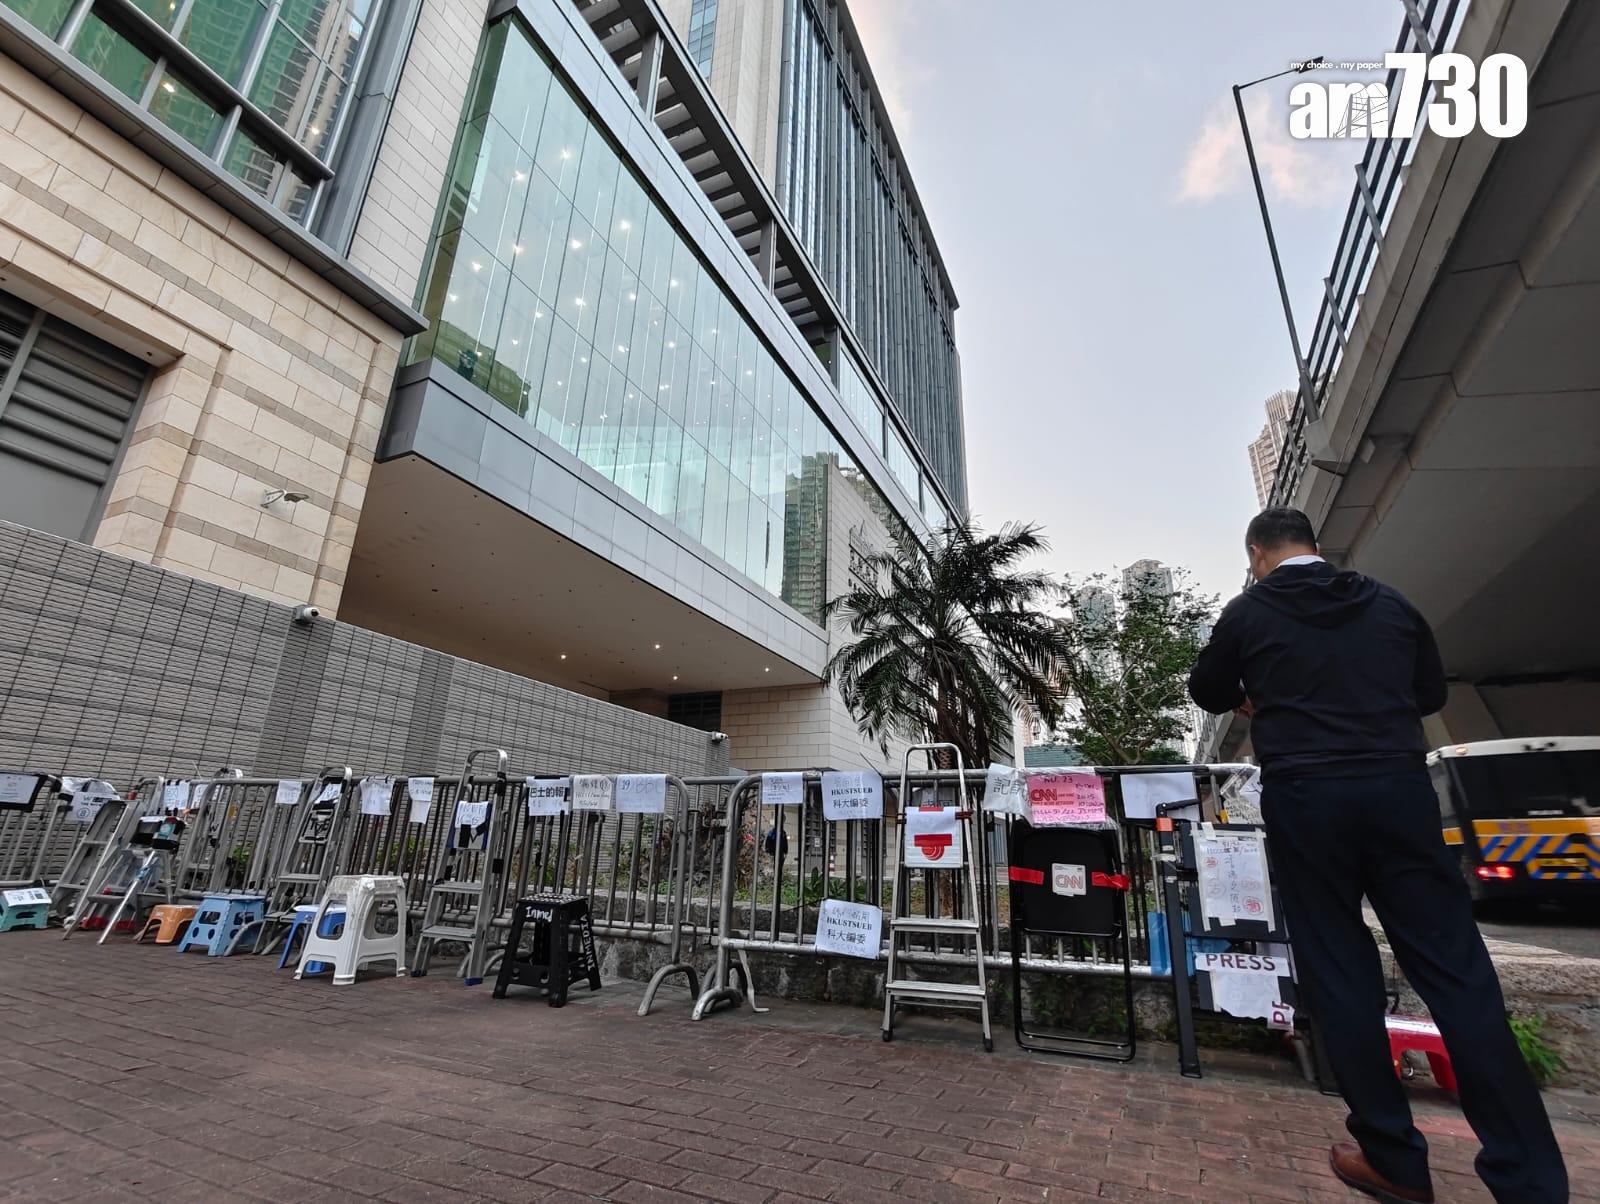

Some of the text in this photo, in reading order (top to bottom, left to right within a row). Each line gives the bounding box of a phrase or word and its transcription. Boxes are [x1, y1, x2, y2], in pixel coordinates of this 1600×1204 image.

[831, 787, 873, 796] HKUSTSUEB
[1030, 788, 1057, 802] CNN
[832, 798, 869, 809] 科大編委
[1055, 875, 1083, 890] CNN
[827, 916, 873, 931] HKUSTSUEB
[581, 914, 596, 972] INMEDIA
[827, 929, 867, 945] 科大編委
[1206, 953, 1275, 971] PRESS
